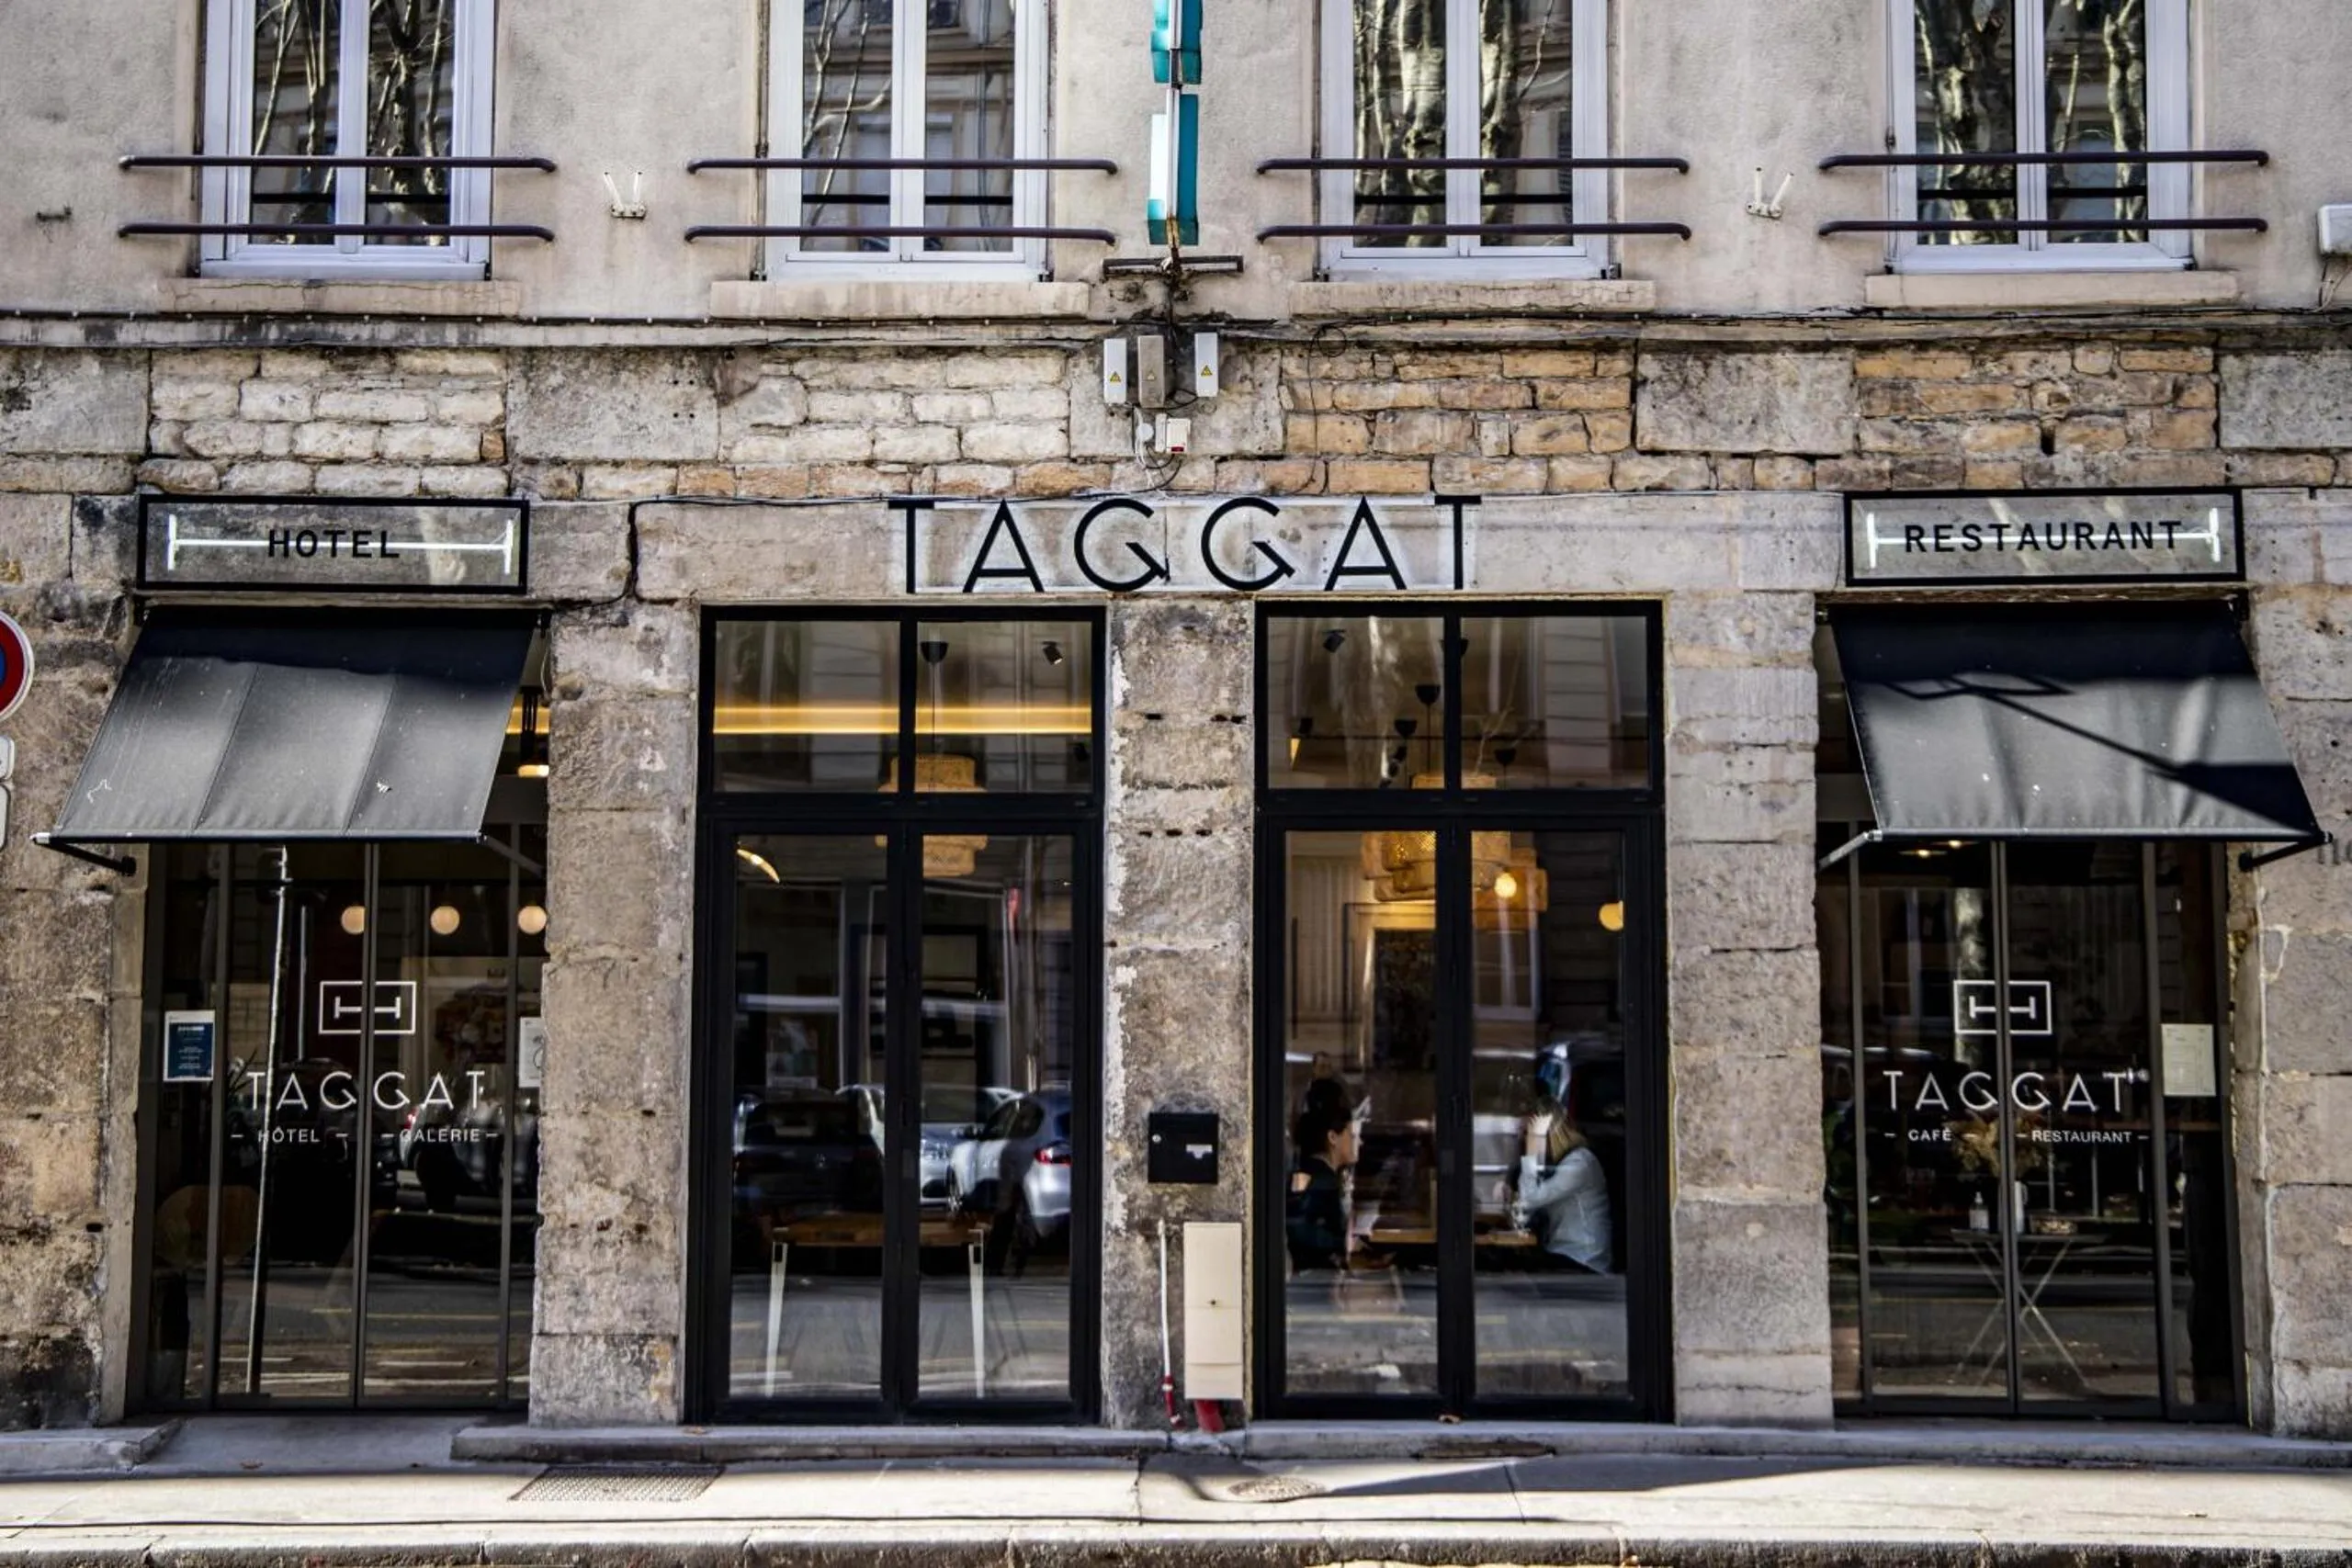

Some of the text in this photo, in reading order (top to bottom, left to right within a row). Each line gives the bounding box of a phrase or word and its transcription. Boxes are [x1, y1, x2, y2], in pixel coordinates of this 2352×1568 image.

[267, 528, 401, 558] HOTEL
[887, 495, 1482, 594] TAGGAT
[1904, 521, 2183, 553] RESTAURANT
[245, 1070, 486, 1111] TAGGAT
[1883, 1070, 2127, 1113] TAGGAT
[256, 1125, 481, 1143] HÔTEL GALERIE
[2031, 1130, 2132, 1144] RESTAURANT
